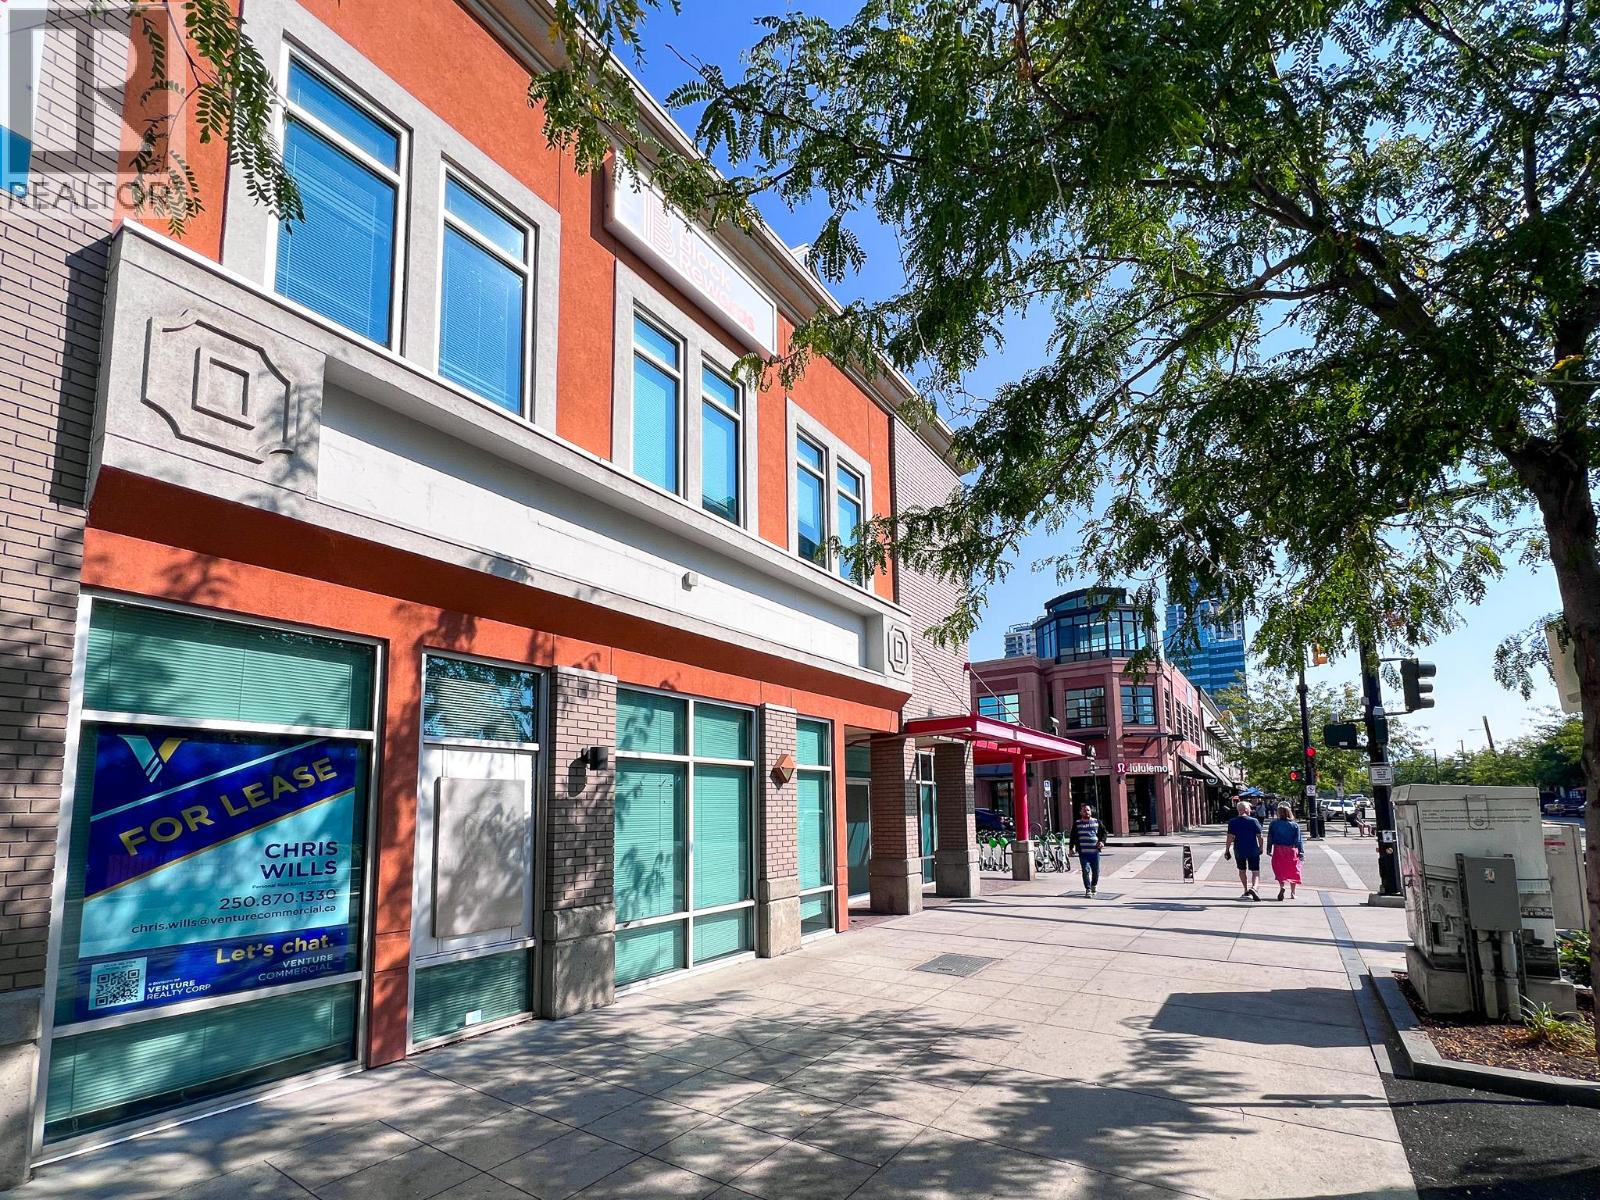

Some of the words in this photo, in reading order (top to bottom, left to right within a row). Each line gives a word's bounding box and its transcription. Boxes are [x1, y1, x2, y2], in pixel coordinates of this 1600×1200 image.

[119, 805, 215, 856] FOR
[219, 757, 338, 817] LEASE
[264, 841, 338, 859] CHRIS
[260, 860, 337, 880] WILLS
[219, 888, 337, 910] 250.870.1330
[131, 903, 337, 934] chris.wills@venturecommercial.ca
[282, 934, 334, 953] chat.
[282, 953, 334, 969] VENTURE
[258, 962, 333, 982] COMMERCIAL
[146, 988, 185, 1001] REALTY
[185, 983, 212, 994] CORP
[147, 979, 196, 993] VENTURE
